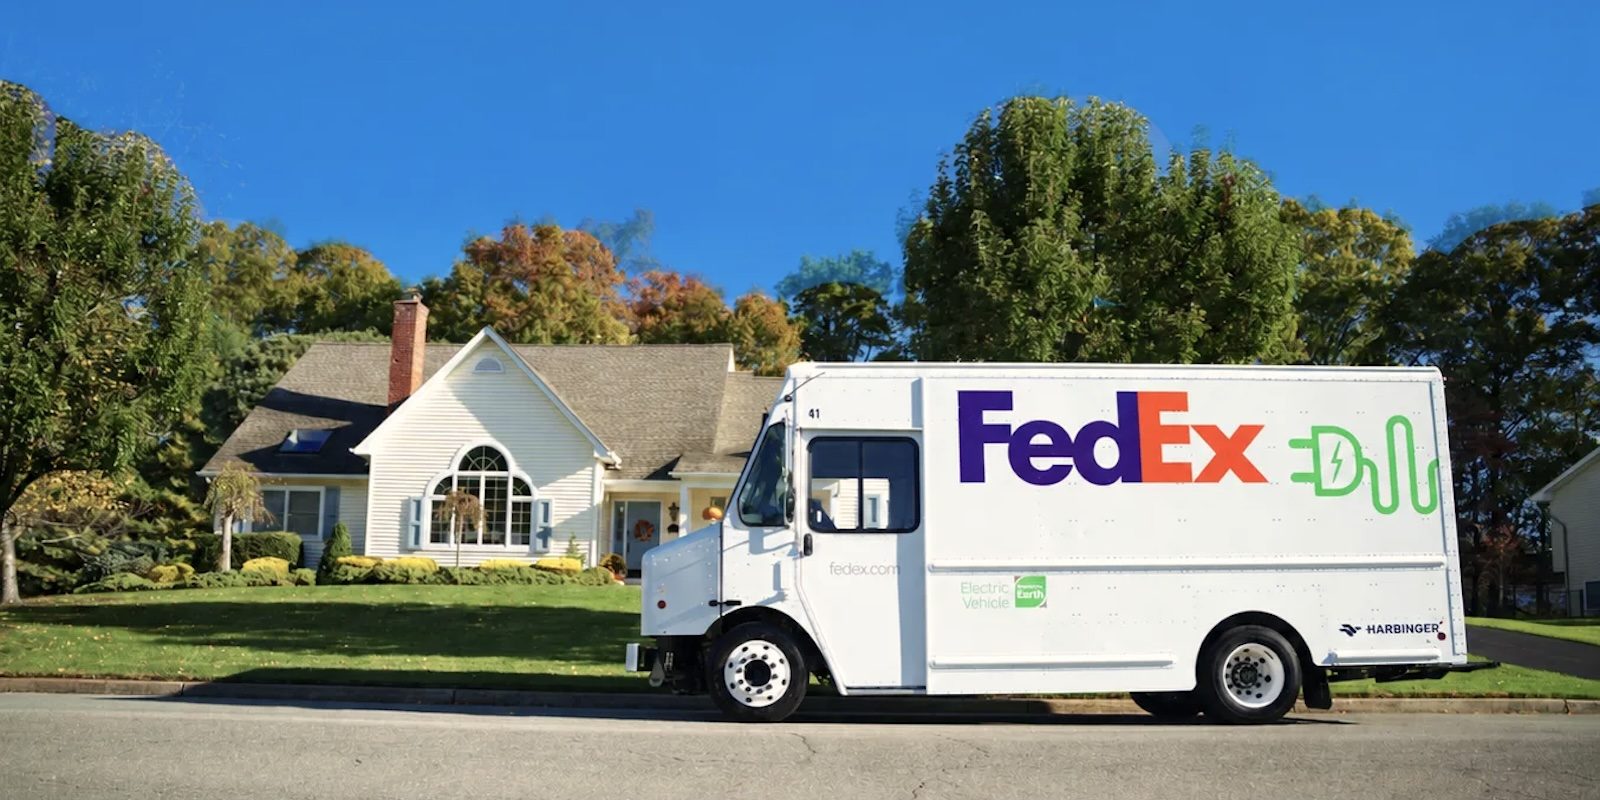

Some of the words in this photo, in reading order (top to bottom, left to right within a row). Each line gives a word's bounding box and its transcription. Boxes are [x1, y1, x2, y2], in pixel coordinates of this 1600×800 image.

[808, 408, 820, 419] 41
[958, 390, 1268, 486] FedEx
[829, 561, 901, 575] fedex.com
[961, 582, 1009, 594] Electric
[962, 596, 1009, 609] Vehicle
[1366, 623, 1439, 635] HARBINGER
